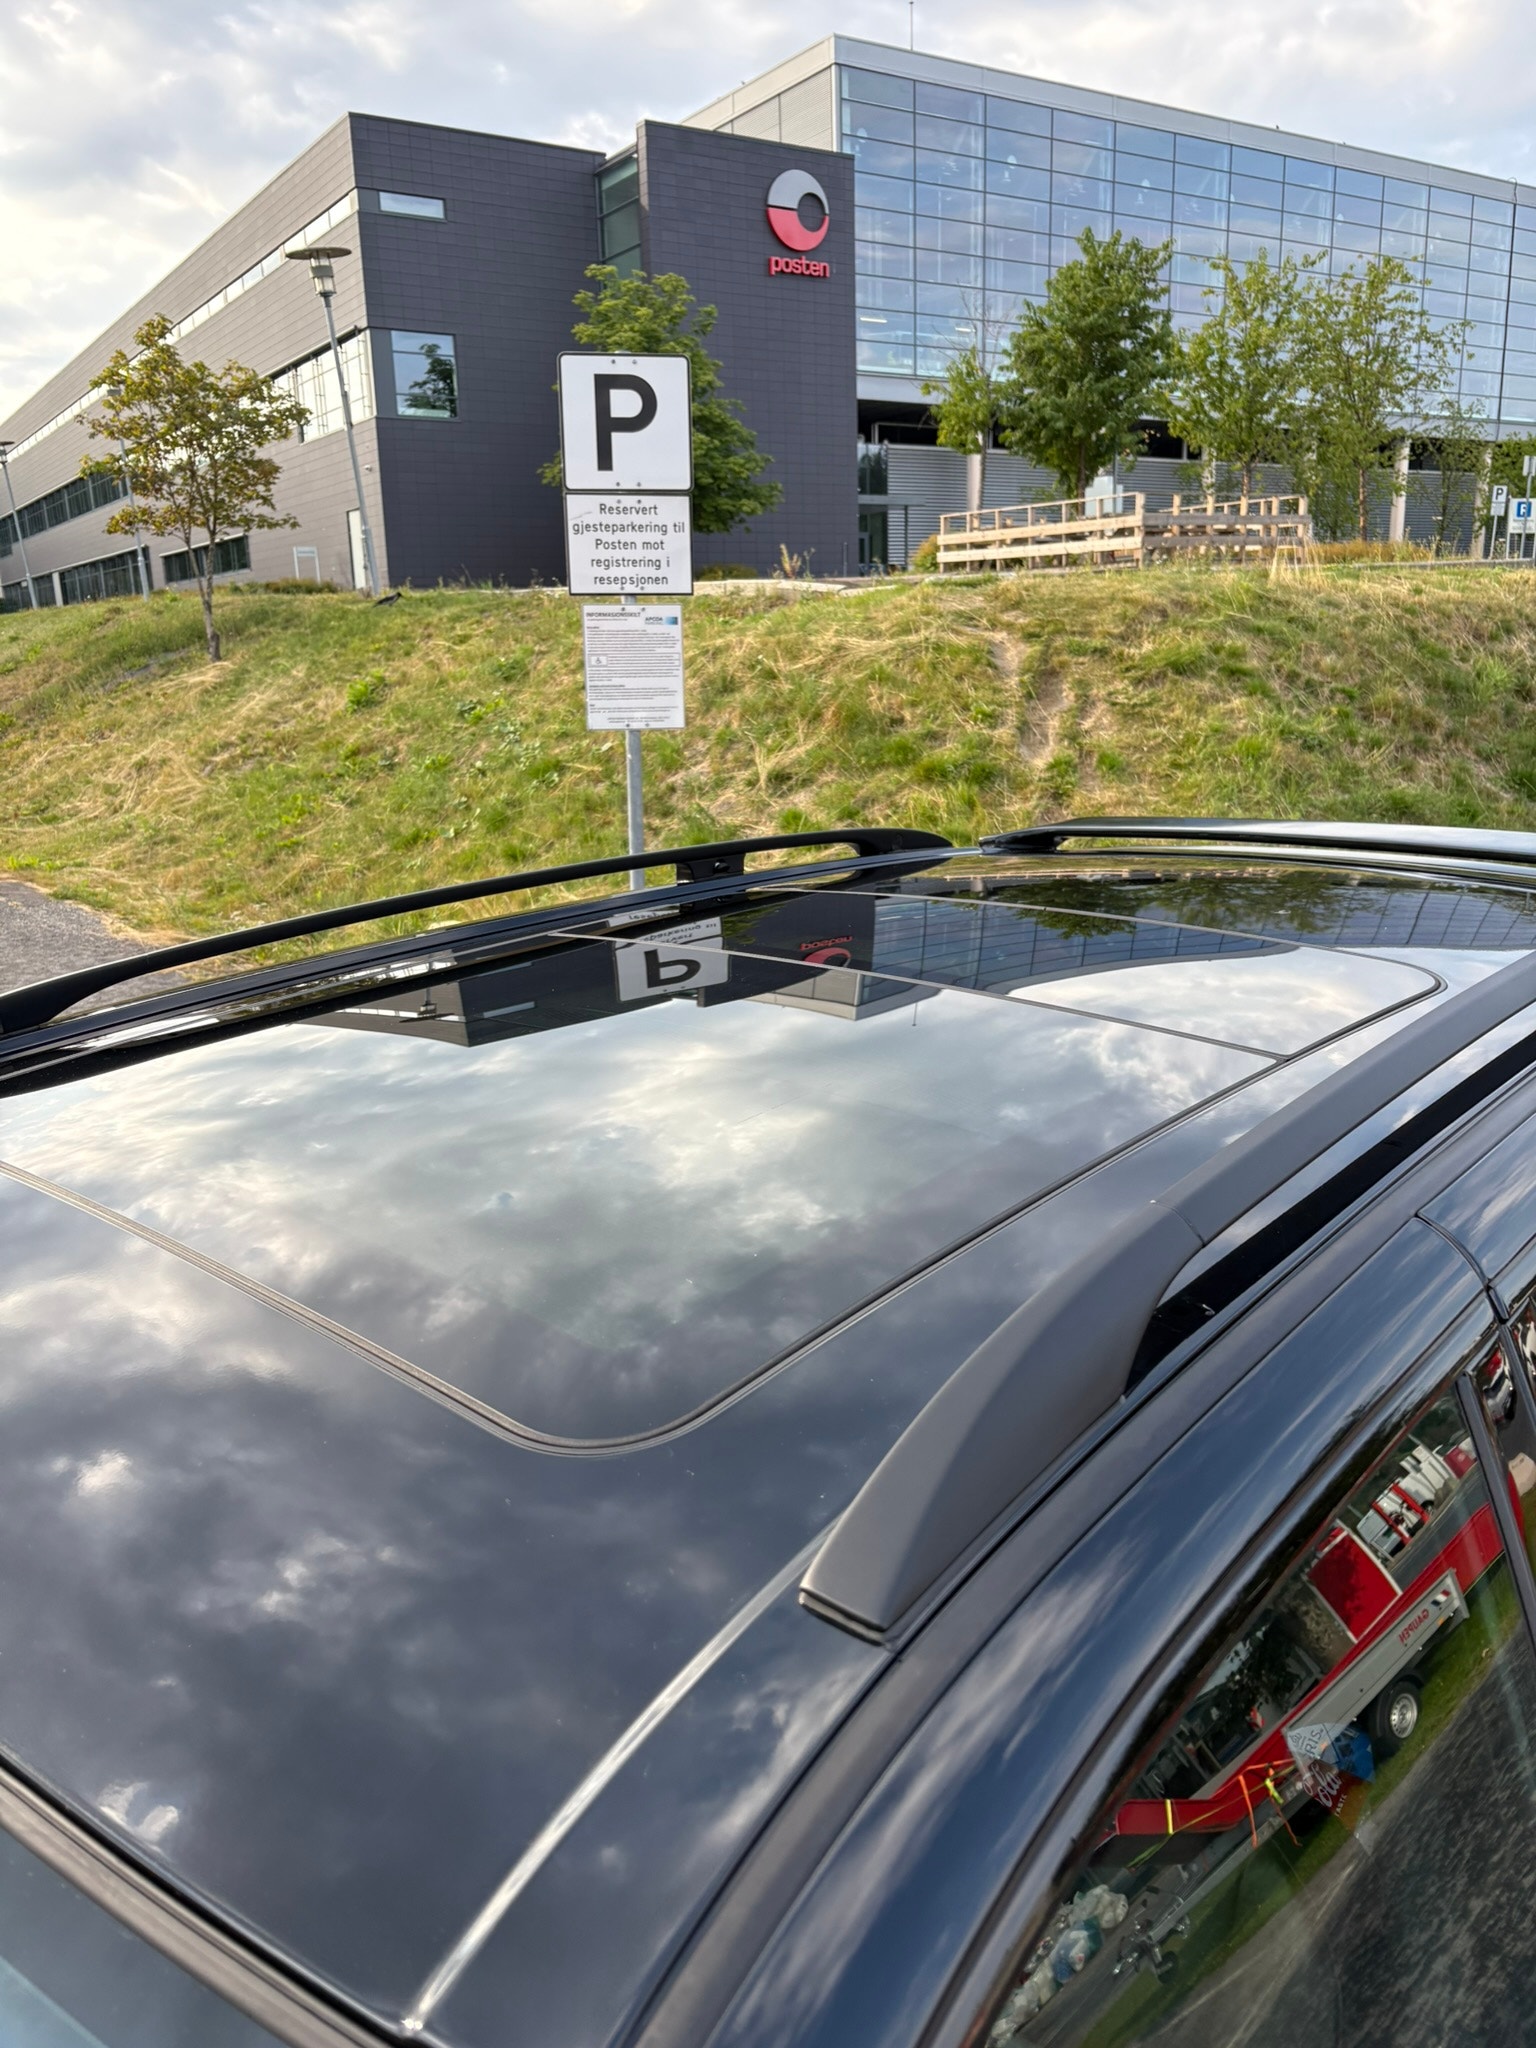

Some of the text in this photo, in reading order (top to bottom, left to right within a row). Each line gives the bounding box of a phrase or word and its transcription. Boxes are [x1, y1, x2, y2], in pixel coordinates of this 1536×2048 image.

[768, 255, 830, 278] posten
[594, 373, 658, 472] P
[1496, 488, 1504, 500] P
[599, 503, 659, 516] Reservert
[572, 520, 686, 536] gjesteparkering til
[595, 538, 666, 551] Posten mot
[590, 556, 671, 571] registrering i
[593, 573, 669, 588] resepsjonen
